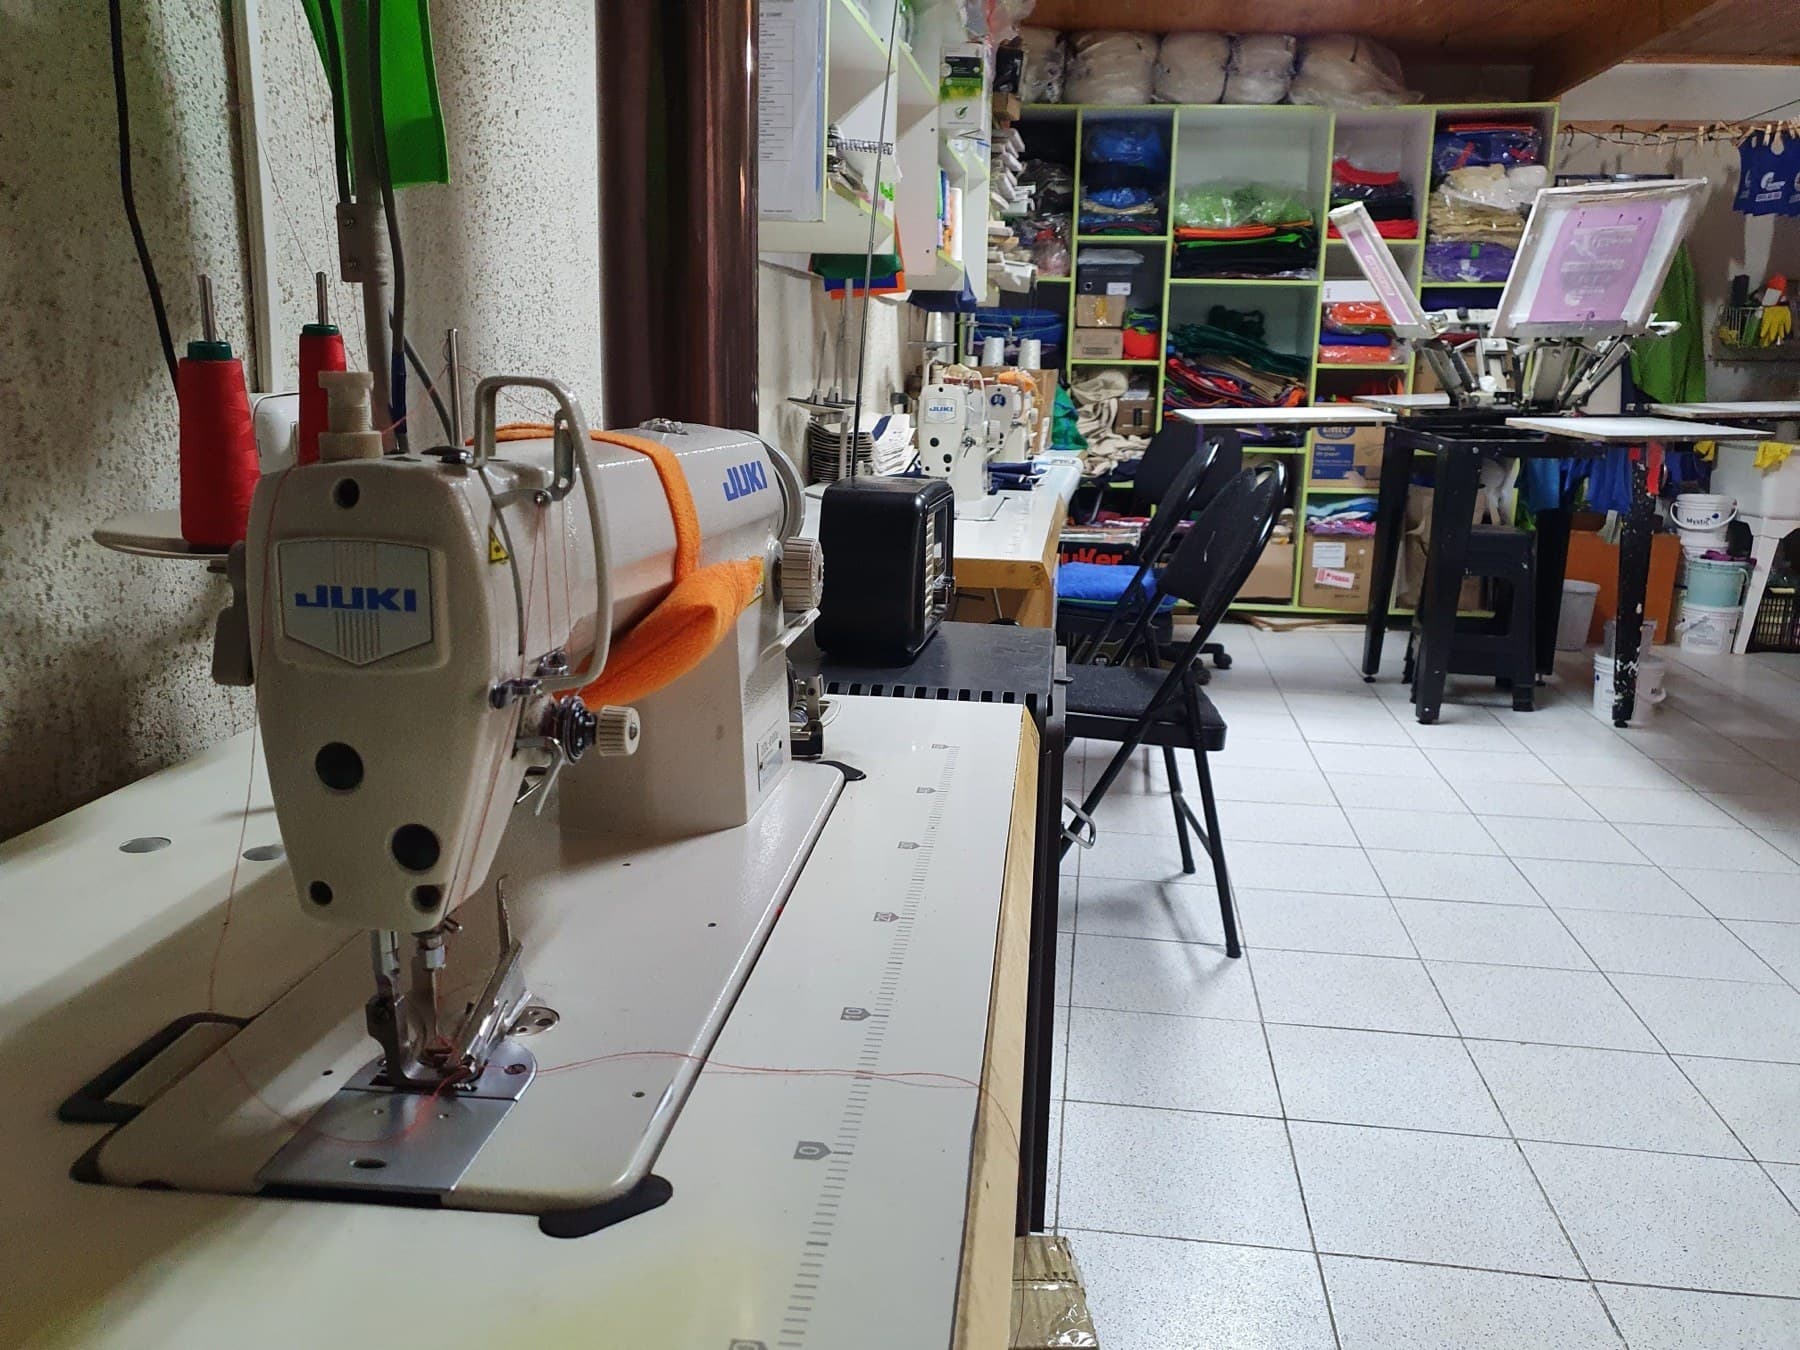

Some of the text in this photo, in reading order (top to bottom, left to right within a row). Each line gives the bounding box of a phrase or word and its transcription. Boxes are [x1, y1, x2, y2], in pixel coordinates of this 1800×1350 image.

[722, 460, 768, 502] JUKI
[295, 585, 416, 611] JUKI
[843, 1007, 864, 1020] 10
[799, 1145, 818, 1156] 0
